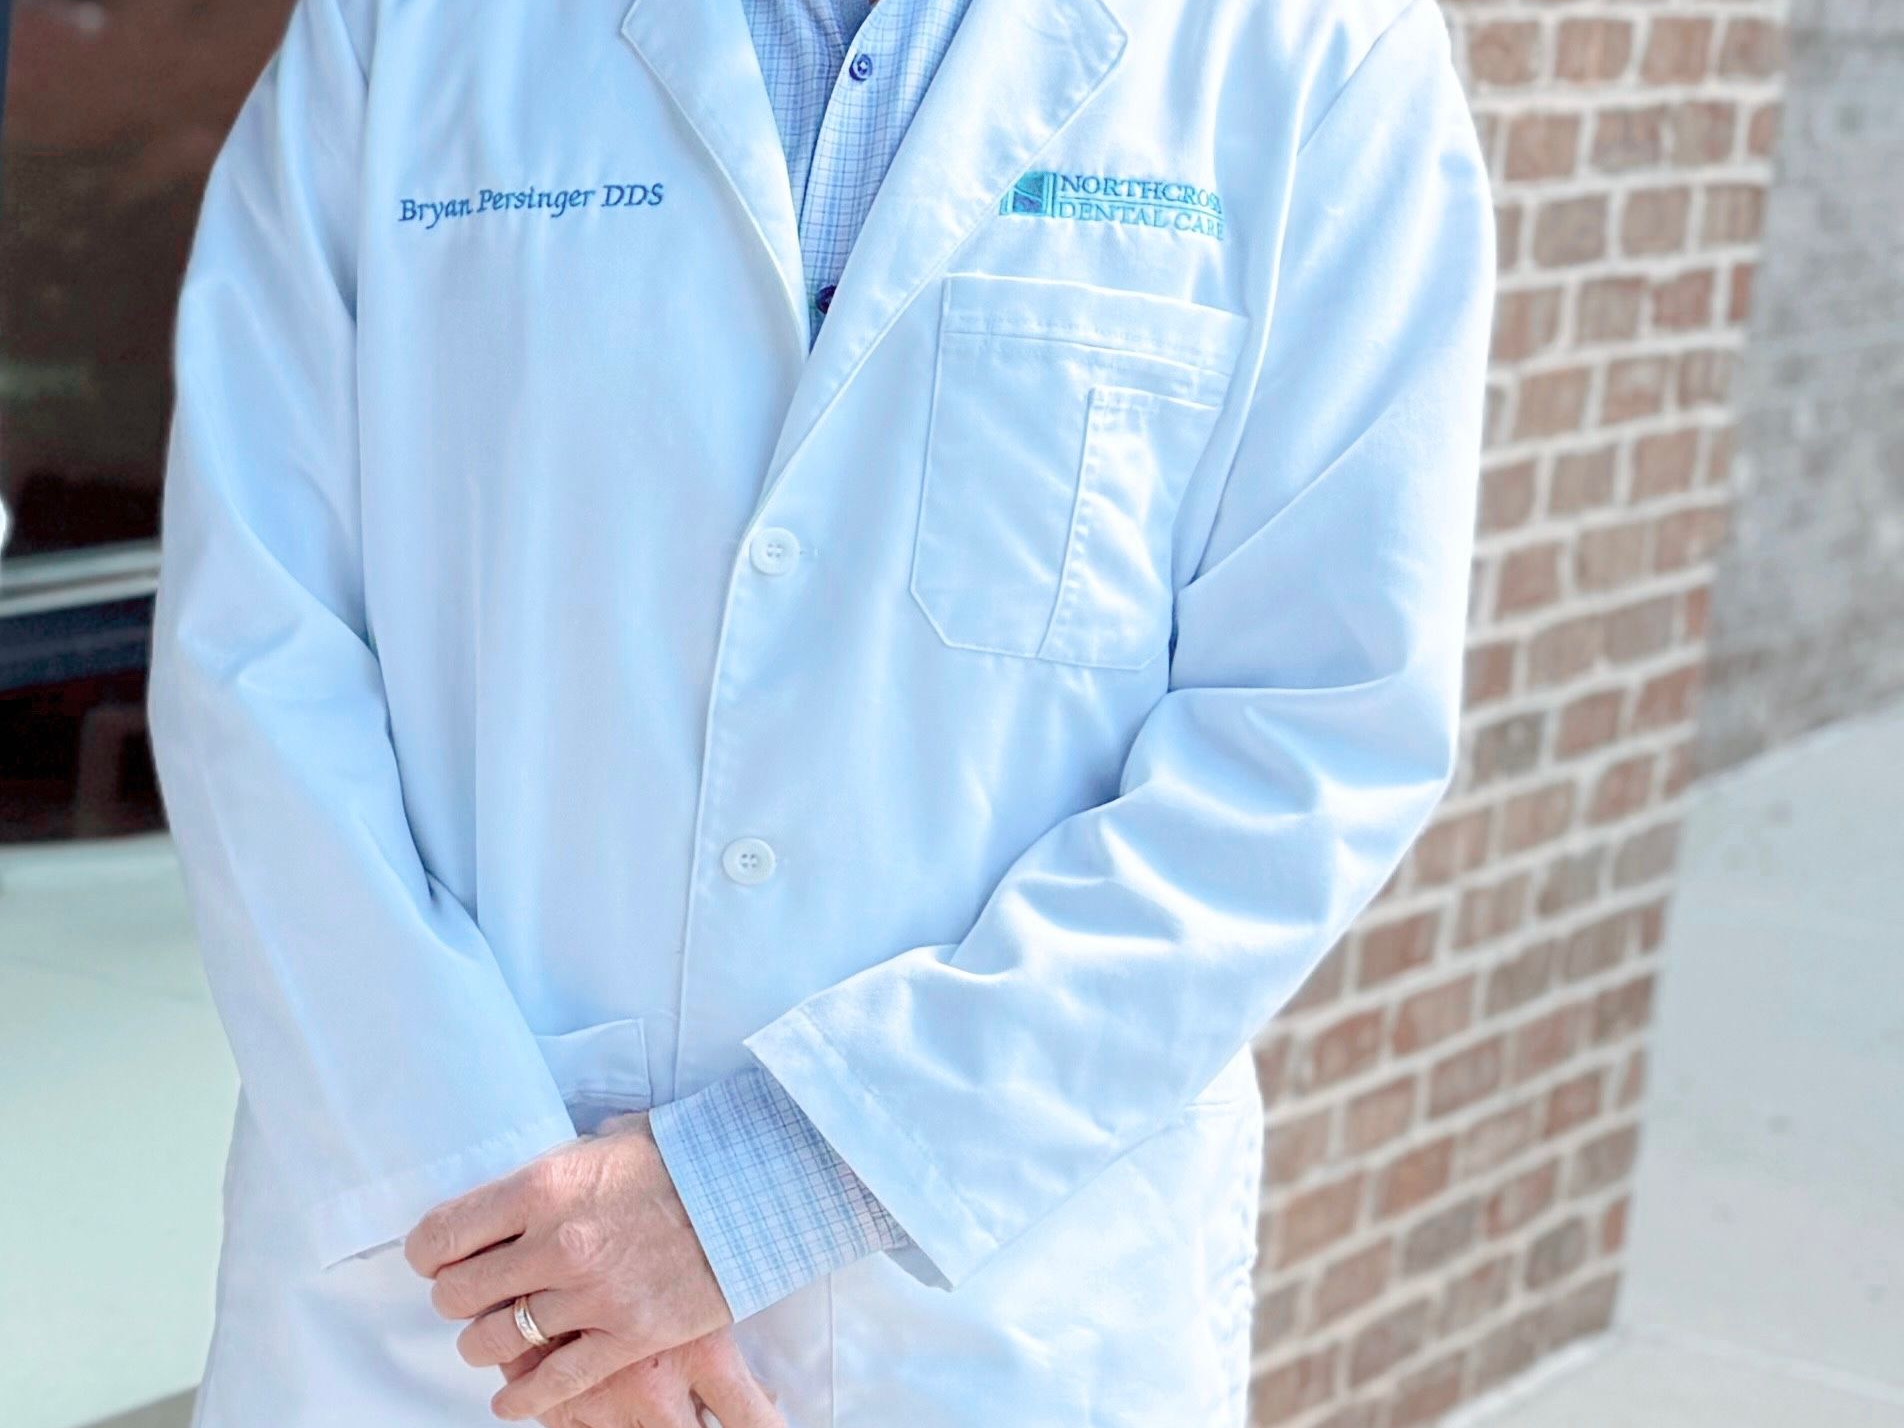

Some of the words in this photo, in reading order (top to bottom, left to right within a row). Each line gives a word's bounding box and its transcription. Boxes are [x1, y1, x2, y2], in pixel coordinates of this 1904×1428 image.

[398, 198, 475, 229] Bryan
[476, 186, 596, 218] Persinger
[601, 183, 665, 208] DDS
[1058, 201, 1167, 228] DENTAL
